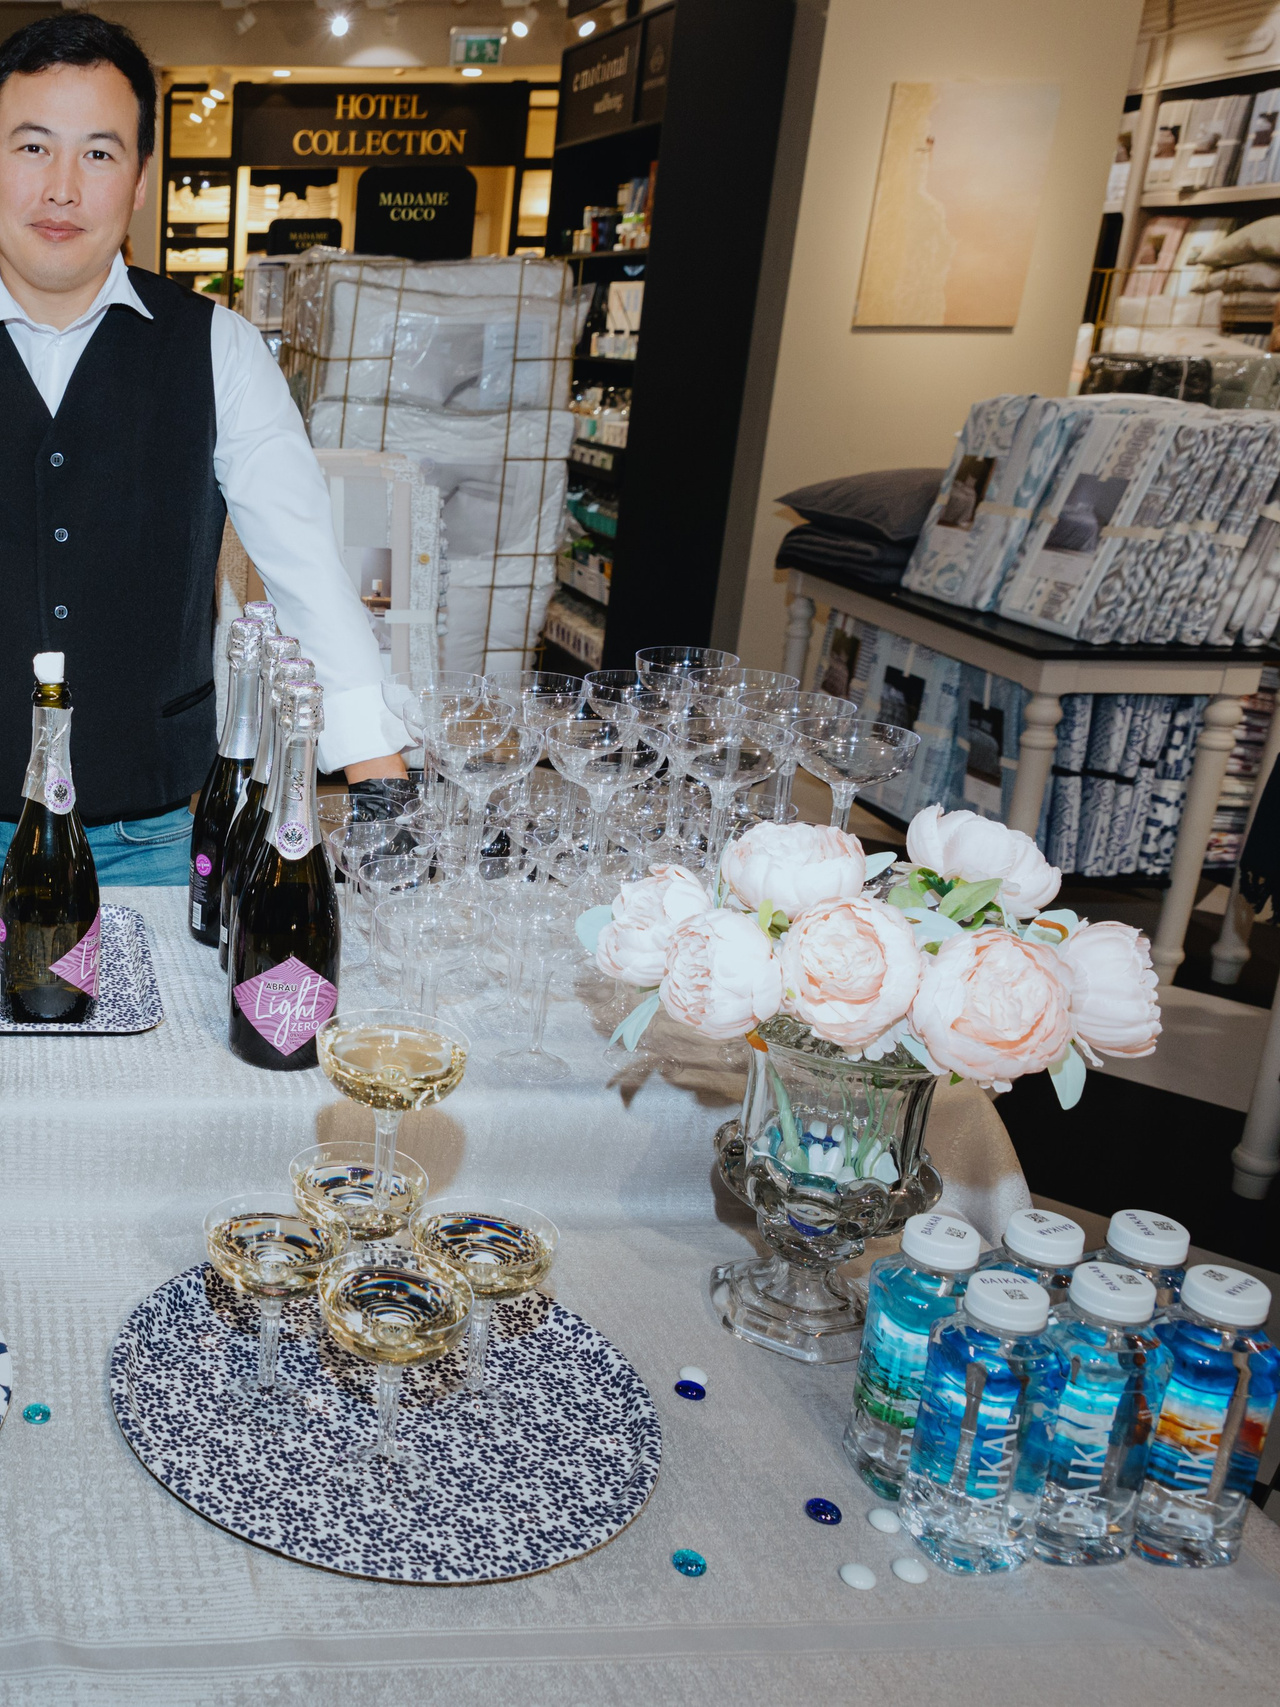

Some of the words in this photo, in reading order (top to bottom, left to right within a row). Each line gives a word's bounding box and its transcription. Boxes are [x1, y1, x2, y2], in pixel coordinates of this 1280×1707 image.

[335, 93, 428, 120] HOTEL
[292, 128, 467, 156] COLLECTION
[378, 192, 449, 207] MADAME
[389, 207, 436, 222] COCO
[265, 982, 297, 992] ABRAU
[255, 975, 329, 1047] Light
[290, 1020, 320, 1032] ZERO
[967, 1413, 1021, 1534] BAIKAL
